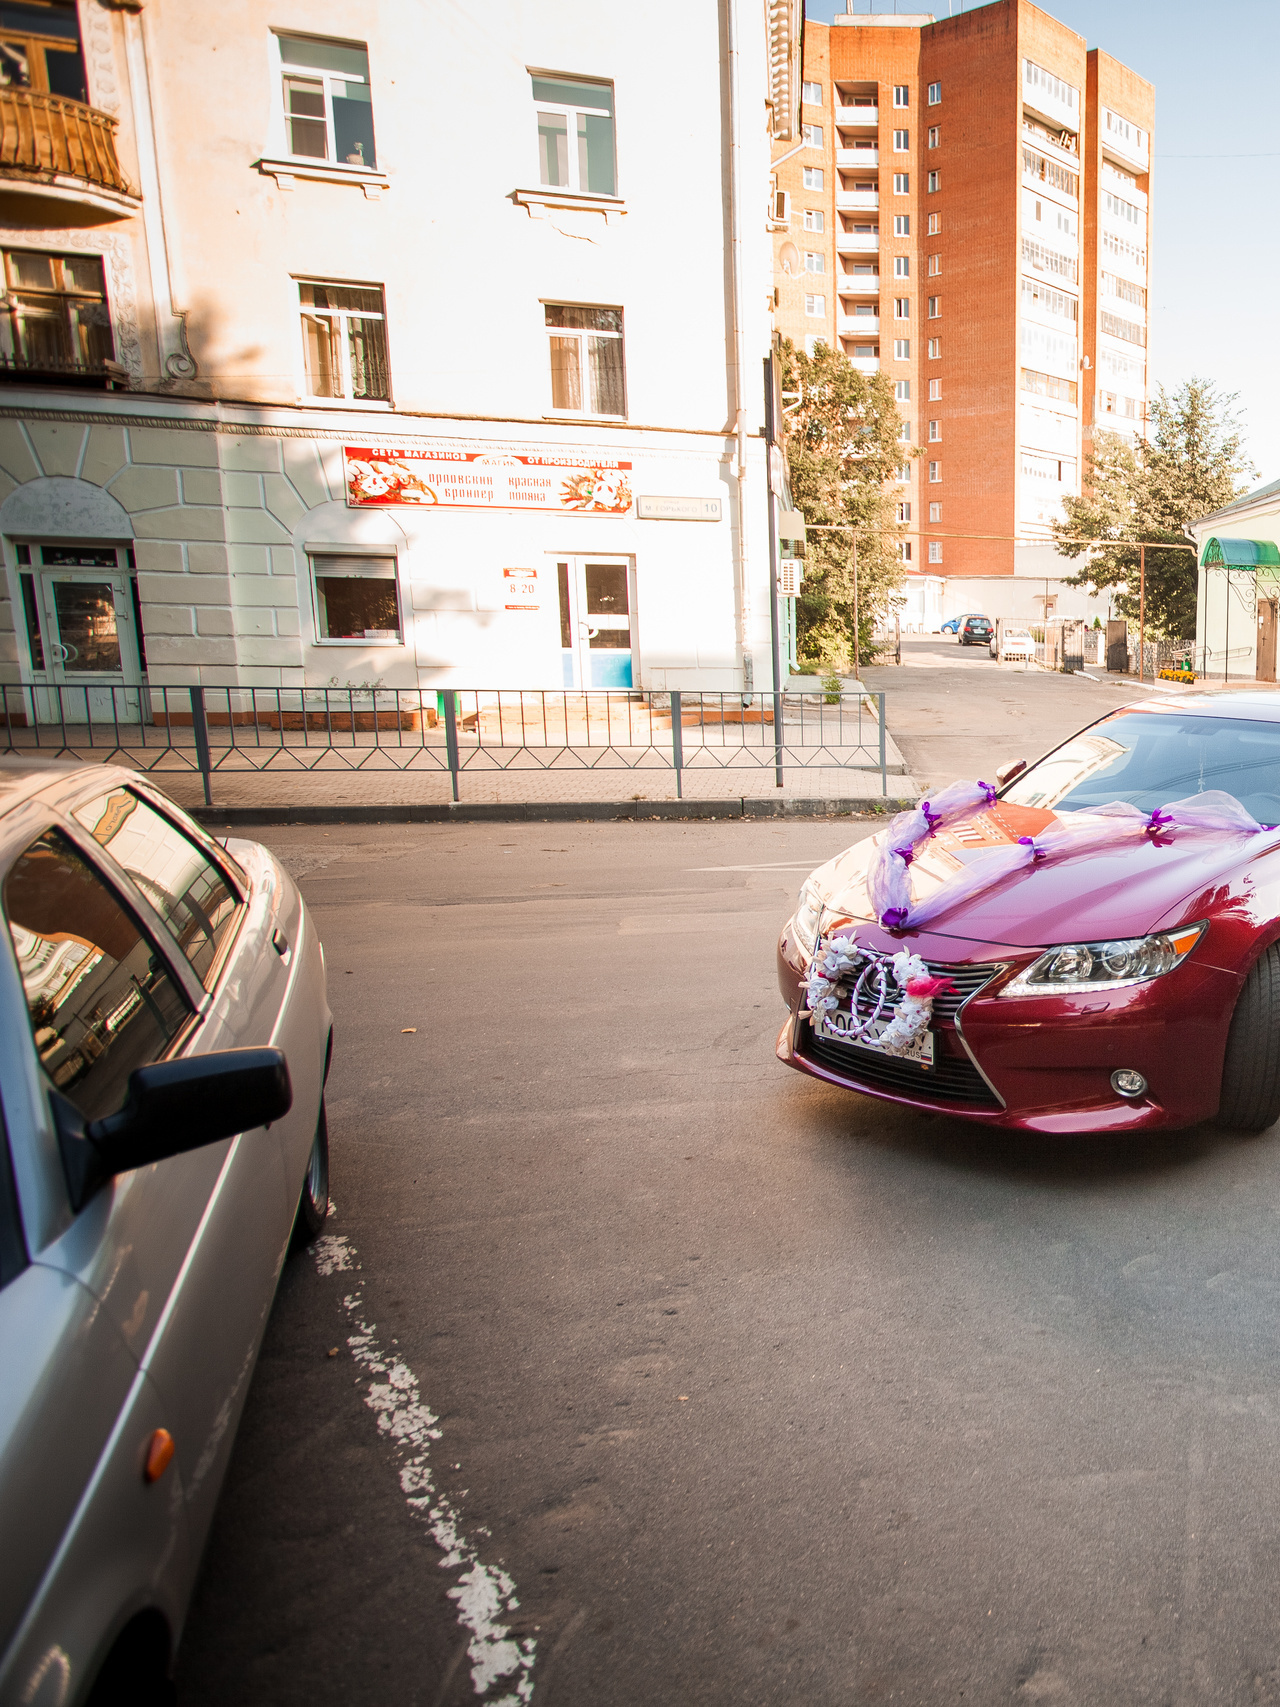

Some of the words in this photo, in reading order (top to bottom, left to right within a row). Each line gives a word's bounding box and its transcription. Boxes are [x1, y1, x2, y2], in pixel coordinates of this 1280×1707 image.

[372, 448, 400, 457] СЕТЬ
[404, 449, 467, 461] МАГАЗИНОВ
[527, 456, 540, 464] ОТ
[541, 457, 619, 468] ПРОИЗВОДИТЕЛЯ
[704, 503, 718, 513] 10
